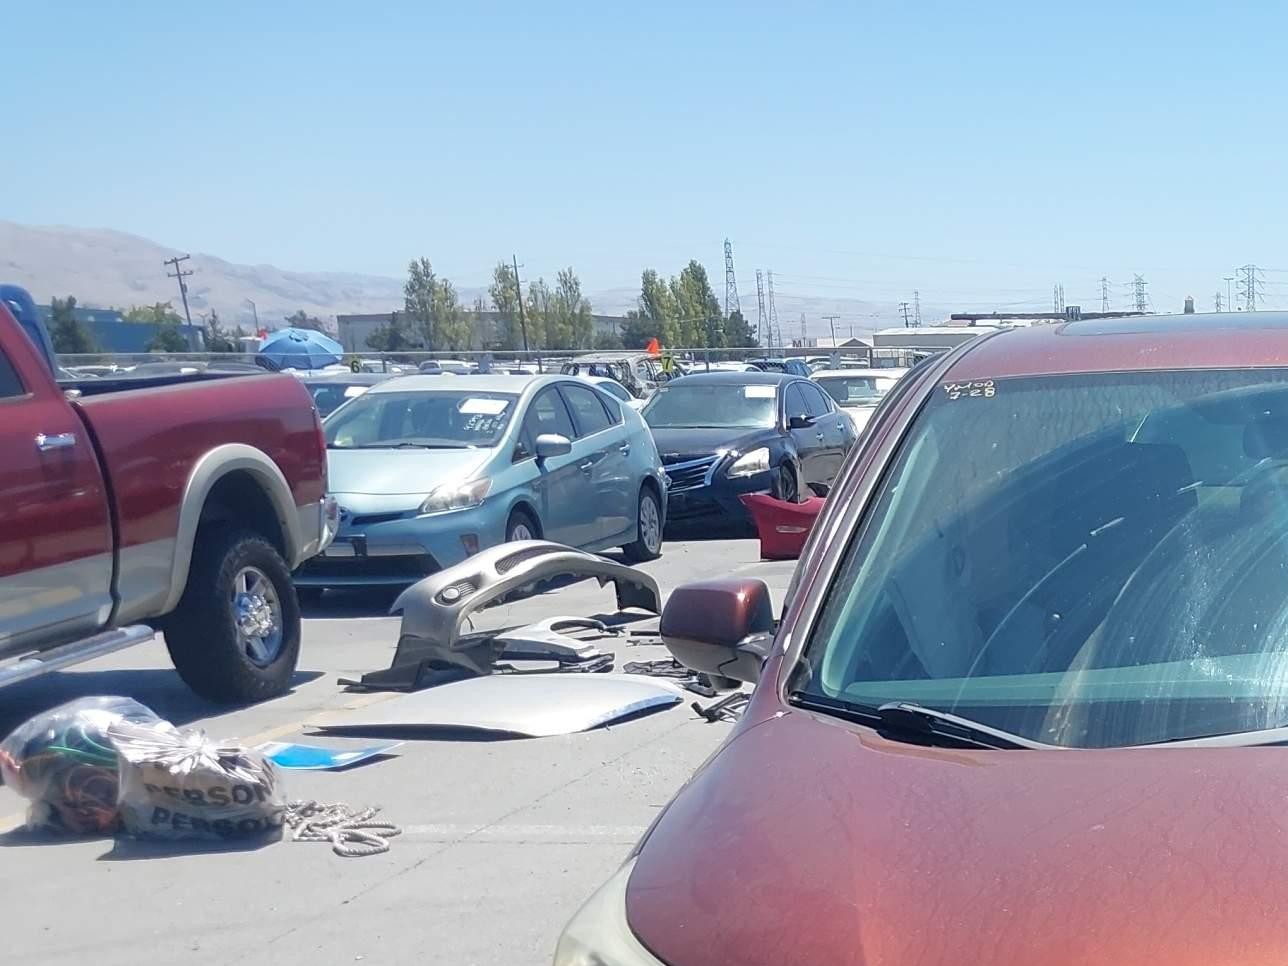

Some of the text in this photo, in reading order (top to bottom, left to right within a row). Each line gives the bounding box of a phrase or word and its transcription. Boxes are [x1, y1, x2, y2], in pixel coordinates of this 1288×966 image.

[351, 360, 360, 373] 6
[663, 356, 671, 370] 7
[950, 387, 996, 400] 7-28
